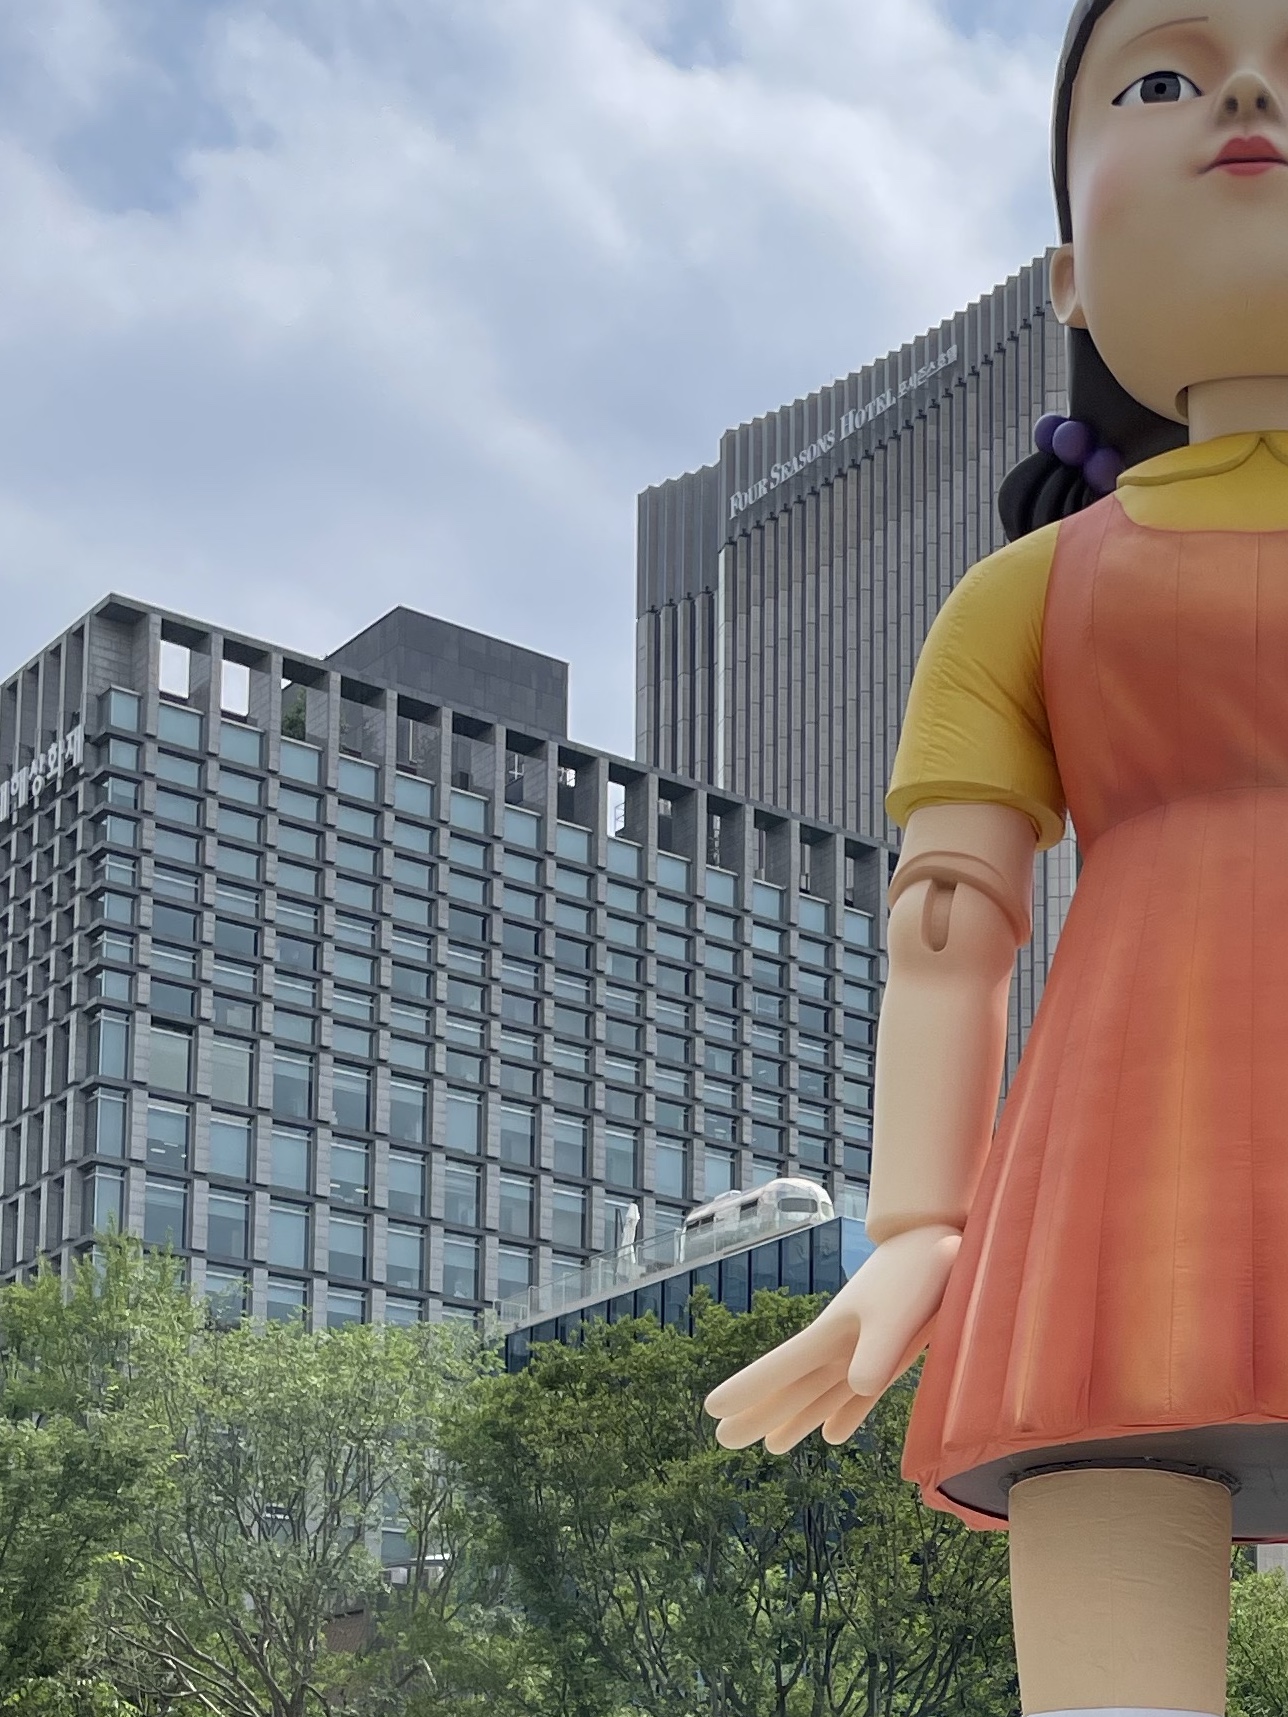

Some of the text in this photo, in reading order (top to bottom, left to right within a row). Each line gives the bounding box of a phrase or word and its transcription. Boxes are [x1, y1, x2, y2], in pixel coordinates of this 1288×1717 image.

[729, 388, 896, 520] FOUR SEASONS HOTEL
